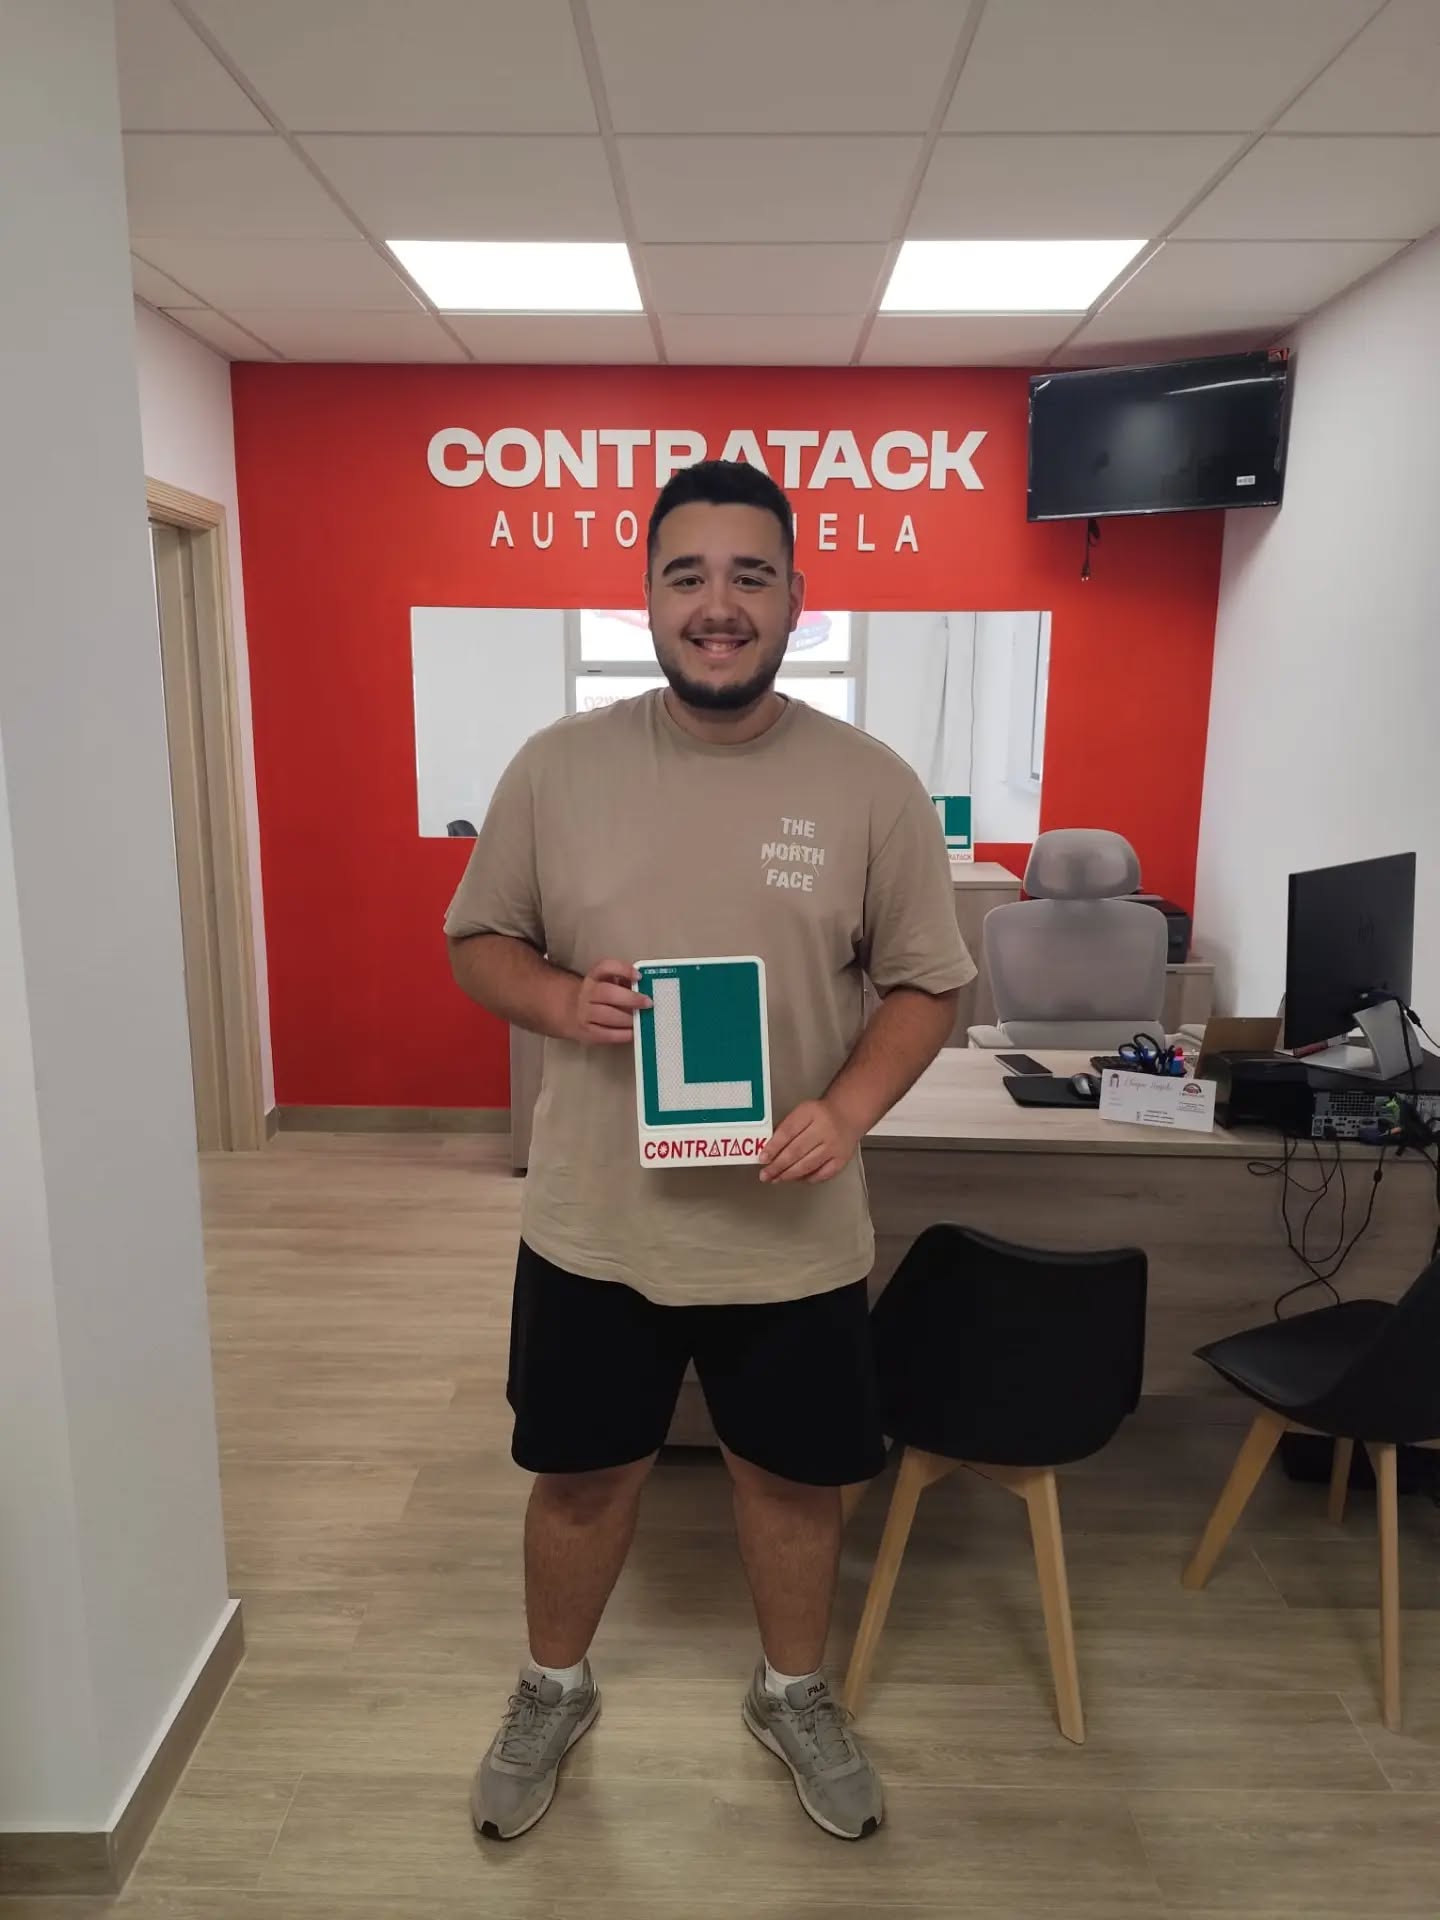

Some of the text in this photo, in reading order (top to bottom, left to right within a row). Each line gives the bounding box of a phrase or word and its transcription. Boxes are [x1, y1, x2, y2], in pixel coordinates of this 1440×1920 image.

[426, 427, 988, 490] CONTRATACK
[490, 510, 919, 552] AUTOELA
[780, 817, 816, 838] THE
[761, 842, 825, 865] NORTH
[766, 869, 814, 892] FACE
[652, 977, 753, 1113] L
[644, 1136, 767, 1160] CONTRATACK
[520, 1679, 538, 1693] FILA
[807, 1682, 825, 1697] FILA
